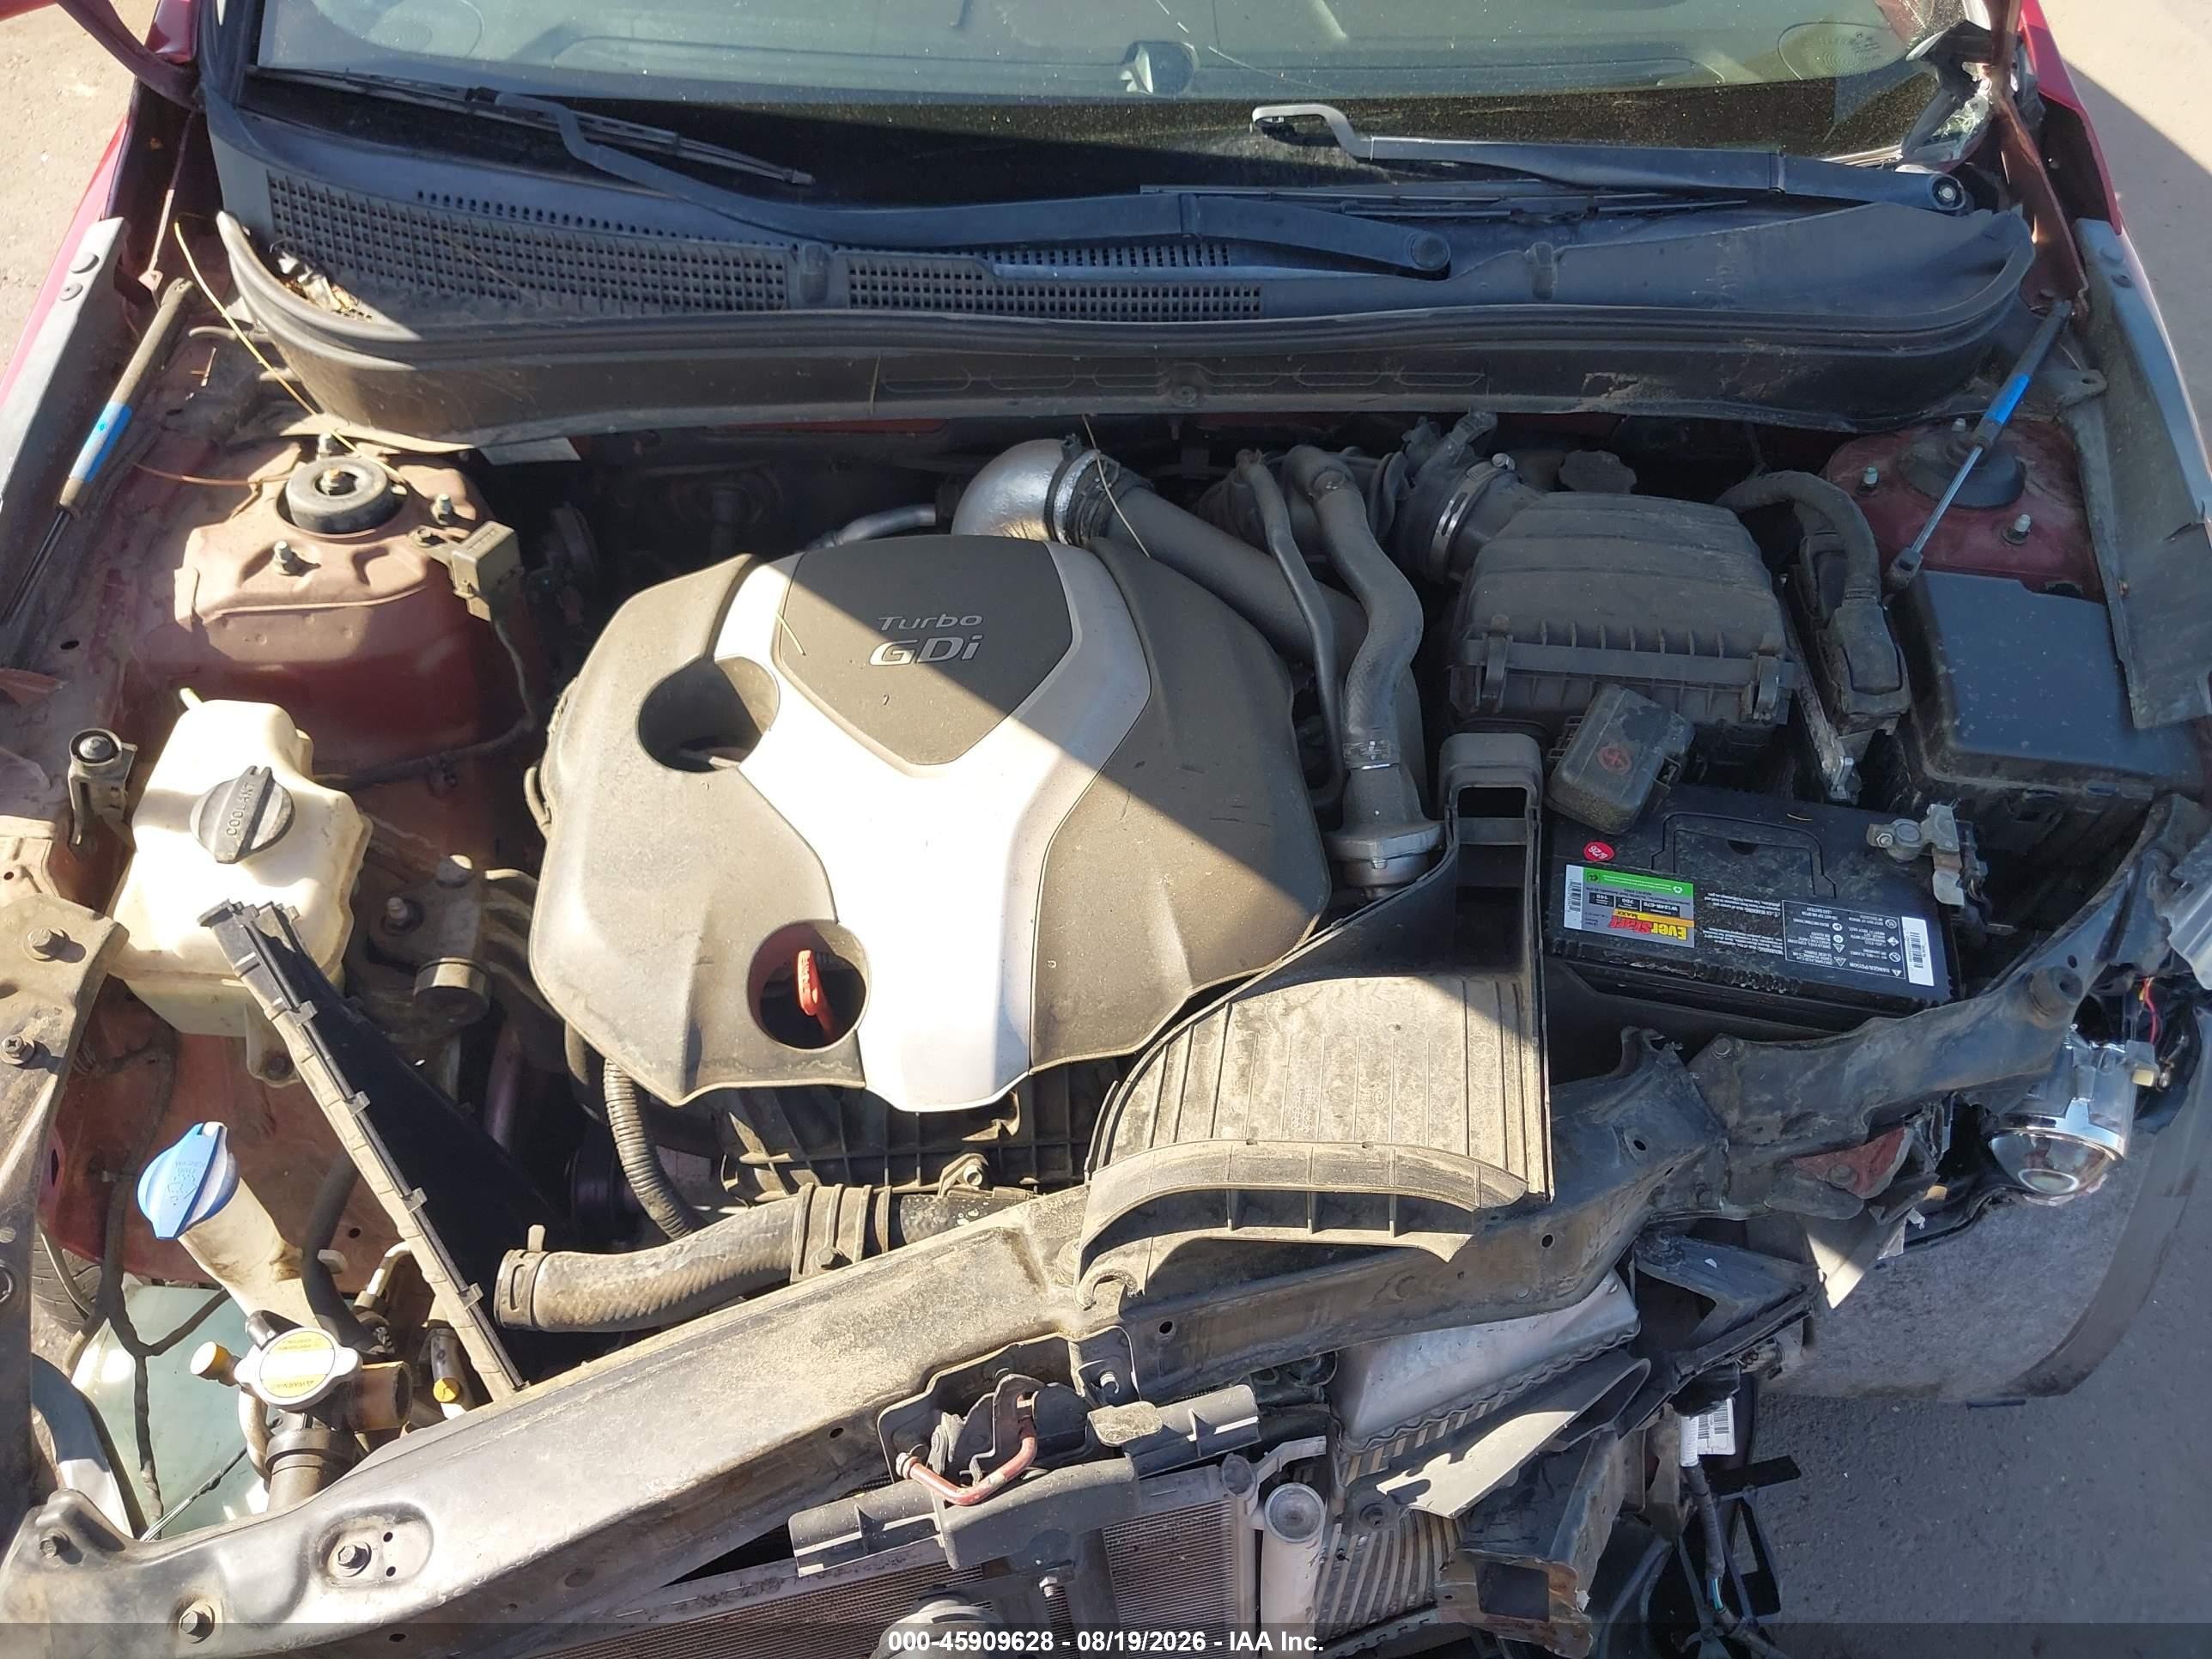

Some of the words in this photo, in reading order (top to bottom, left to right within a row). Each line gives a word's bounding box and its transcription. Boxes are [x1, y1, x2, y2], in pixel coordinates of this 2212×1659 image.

[878, 613, 983, 631] Turbo
[869, 635, 984, 666] GDi
[227, 782, 255, 836] COOLANT
[1608, 916, 1686, 940] EverStart
